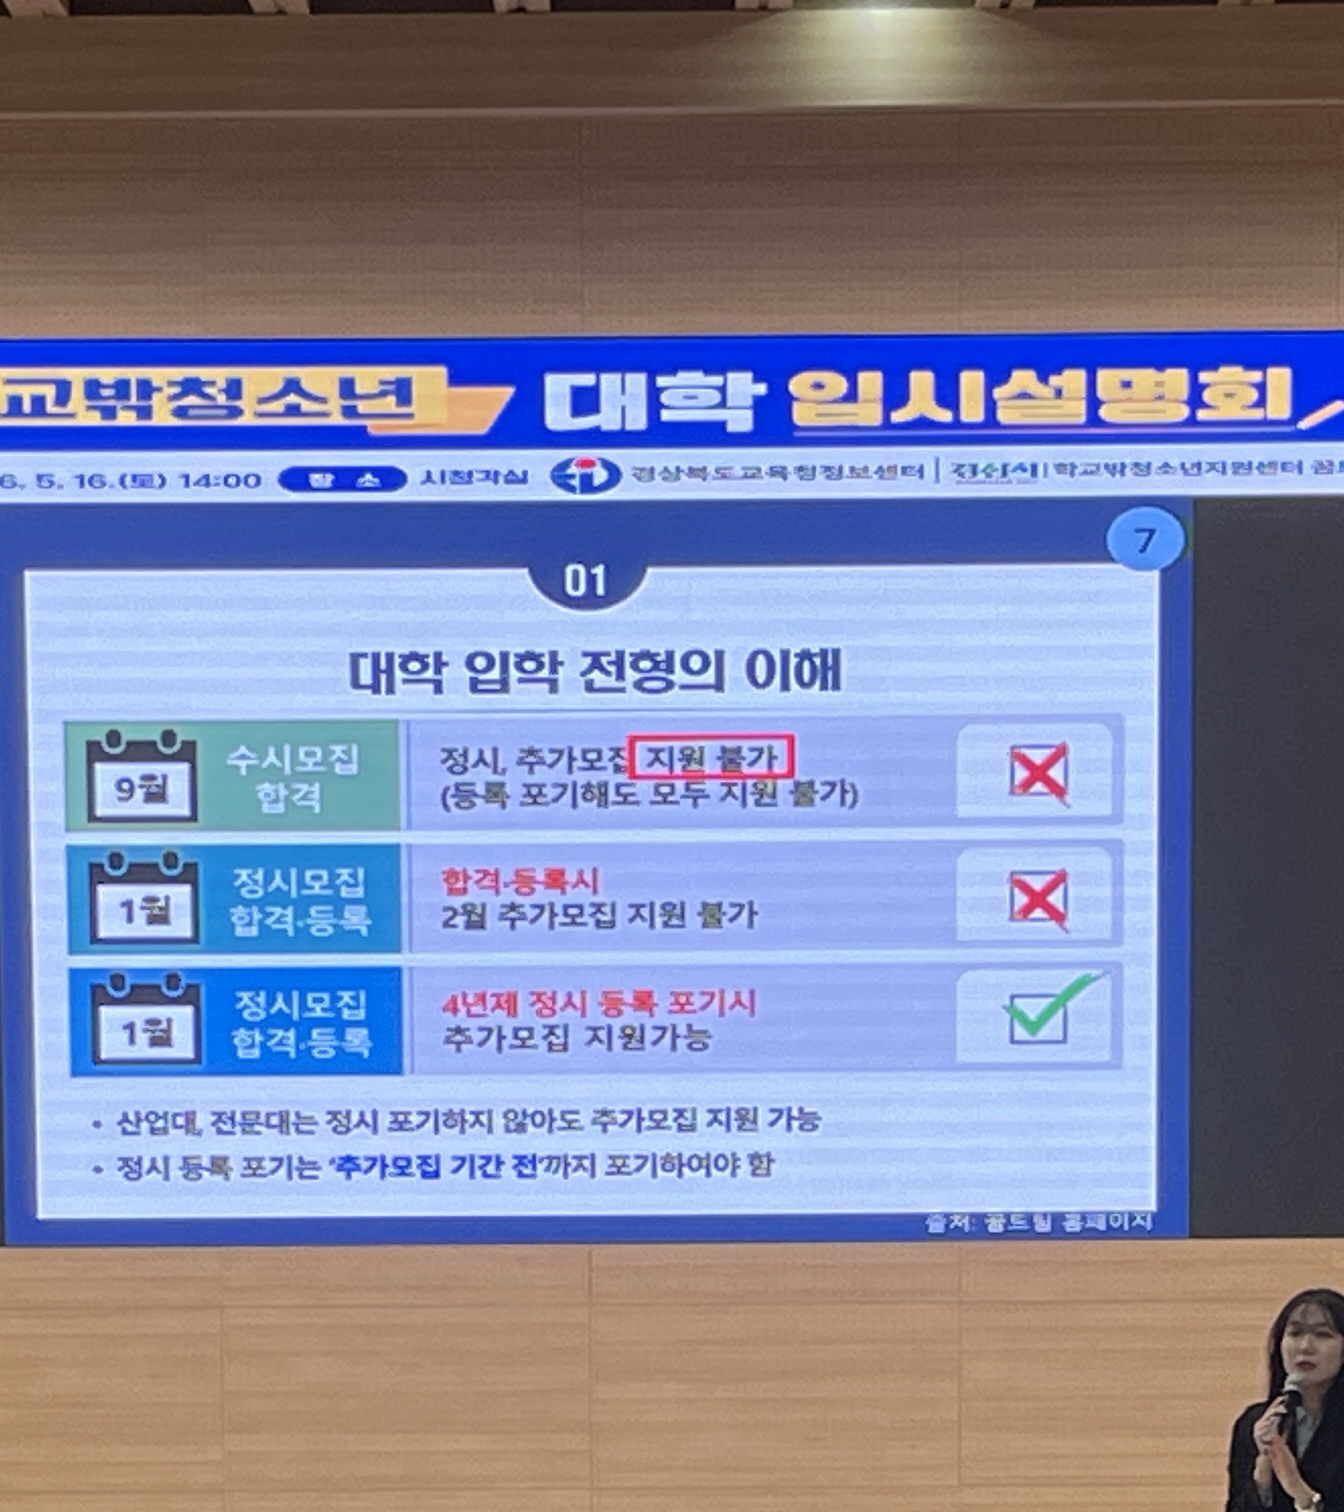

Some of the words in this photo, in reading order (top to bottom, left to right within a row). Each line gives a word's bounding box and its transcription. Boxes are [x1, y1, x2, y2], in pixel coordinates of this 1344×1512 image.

[542, 369, 767, 432] 대학
[788, 365, 1294, 426] 입시설명회
[35, 473, 65, 490] 5.
[180, 472, 262, 489] 14:00
[1134, 528, 1156, 554] 7
[564, 563, 607, 598] 01
[348, 649, 449, 697] 대학
[464, 648, 565, 696] 입학
[579, 647, 728, 696] 전형의
[745, 646, 844, 694] 이해
[226, 743, 360, 777] 수시모집
[440, 745, 507, 776] 정시,
[645, 744, 707, 773] 지원
[716, 744, 779, 773] 불가
[114, 773, 170, 805] 9월
[255, 782, 322, 815] 합격
[441, 781, 511, 812] (등록
[519, 780, 642, 810] 포기해도
[649, 780, 711, 809] 모두
[720, 779, 779, 808] 지원
[788, 778, 860, 809] 불가)
[233, 867, 366, 900] 정시모집
[118, 895, 172, 926] 1월
[441, 902, 488, 931] 2월
[497, 901, 618, 931] 추가모집
[628, 901, 688, 930] 지원
[697, 900, 760, 930] 불가
[234, 989, 367, 1022] 정시모집
[441, 989, 520, 1018] 4년제
[528, 989, 589, 1018] 정시
[598, 988, 660, 1017] 등록
[667, 988, 758, 1018] 포기시
[121, 1018, 175, 1049] 1월
[443, 1023, 570, 1053] 추가모집
[584, 1022, 713, 1052] 지원가능
[116, 1108, 203, 1137] 산업대,
[210, 1108, 320, 1136] 전문대는
[325, 1108, 379, 1136] 정시
[387, 1108, 494, 1136] 포기하지
[502, 1107, 584, 1135] 않아도
[590, 1106, 699, 1134] 추가모집
[705, 1106, 760, 1133] 지원
[767, 1105, 823, 1133] 가능
[117, 1153, 172, 1182] 정시
[178, 1153, 233, 1181] 등록
[240, 1153, 323, 1181] 포기는
[450, 1152, 505, 1180] 기간
[604, 1150, 742, 1179] 포기하여야
[747, 1150, 776, 1179] 함
